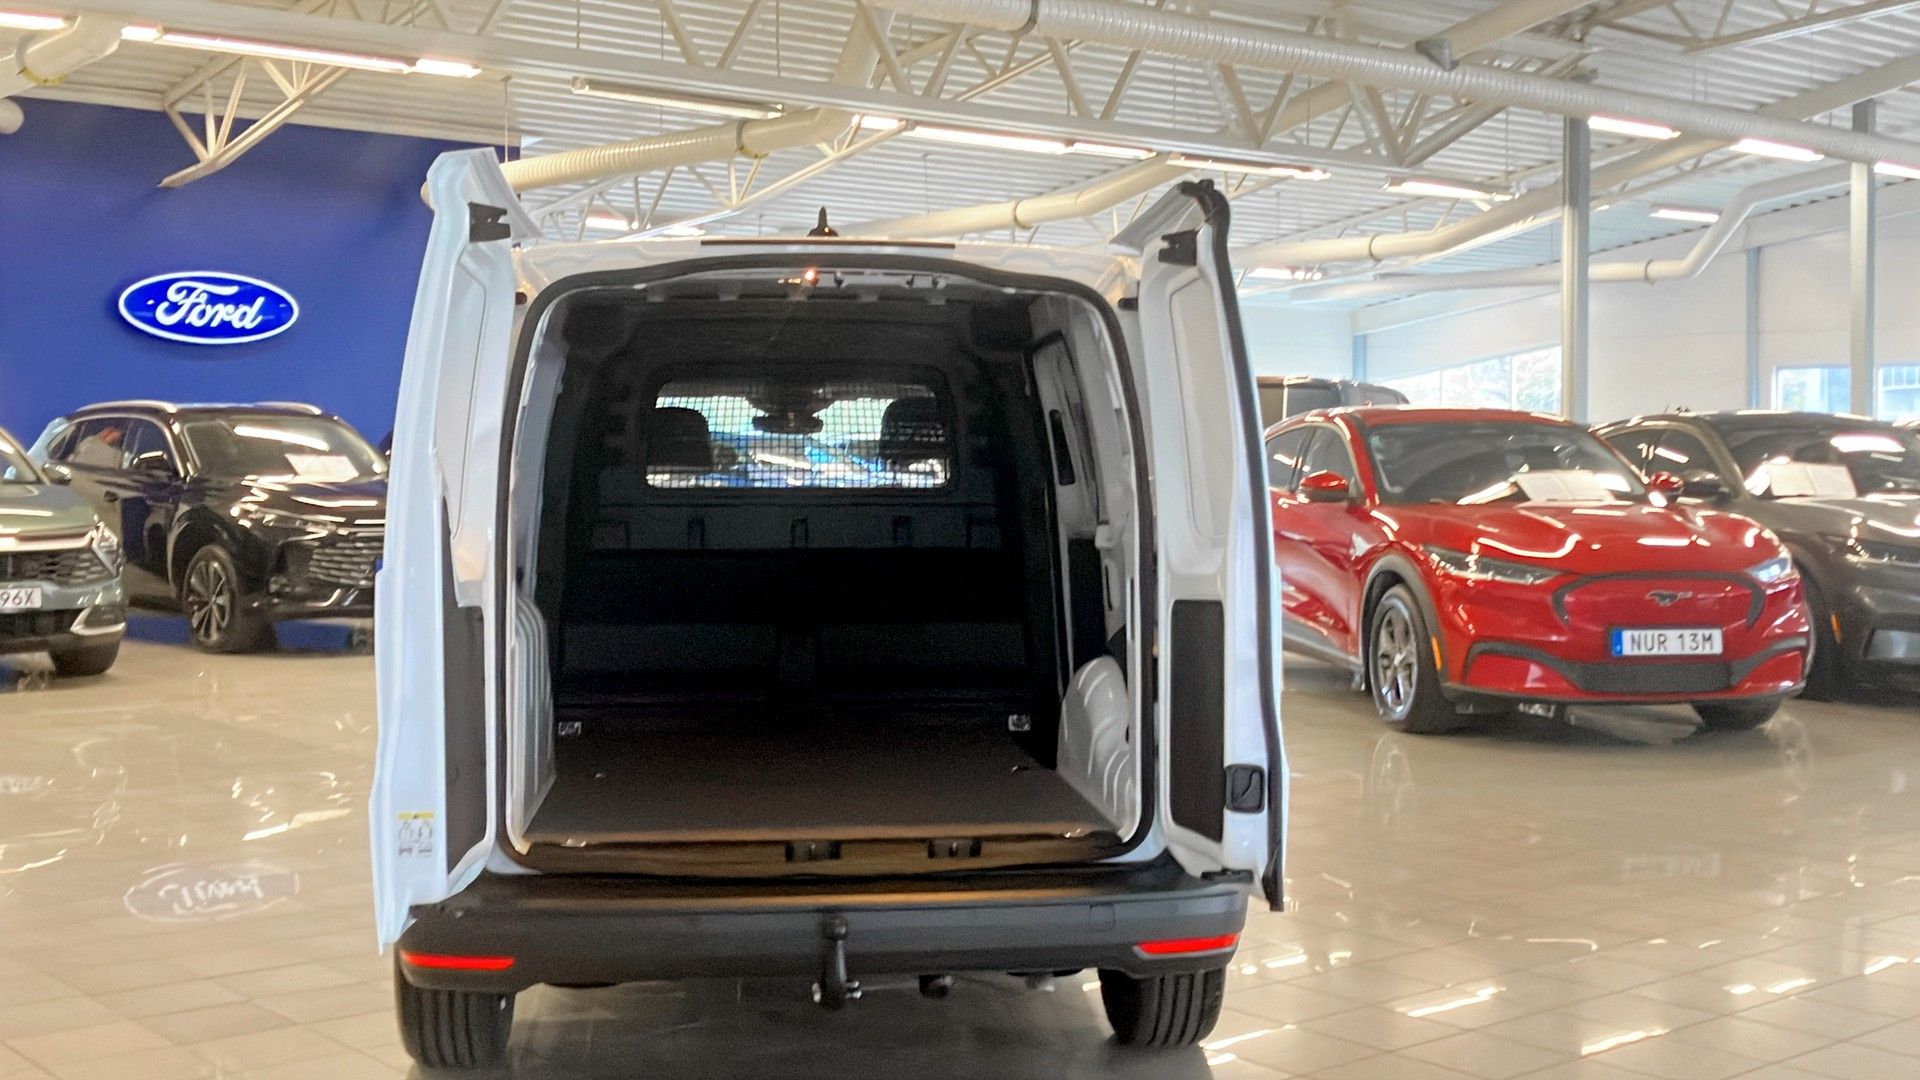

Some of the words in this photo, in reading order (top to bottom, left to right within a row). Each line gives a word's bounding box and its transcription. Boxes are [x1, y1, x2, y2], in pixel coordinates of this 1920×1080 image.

[155, 281, 265, 329] Ford
[1630, 633, 1668, 652] NUR
[1678, 632, 1714, 651] 13M
